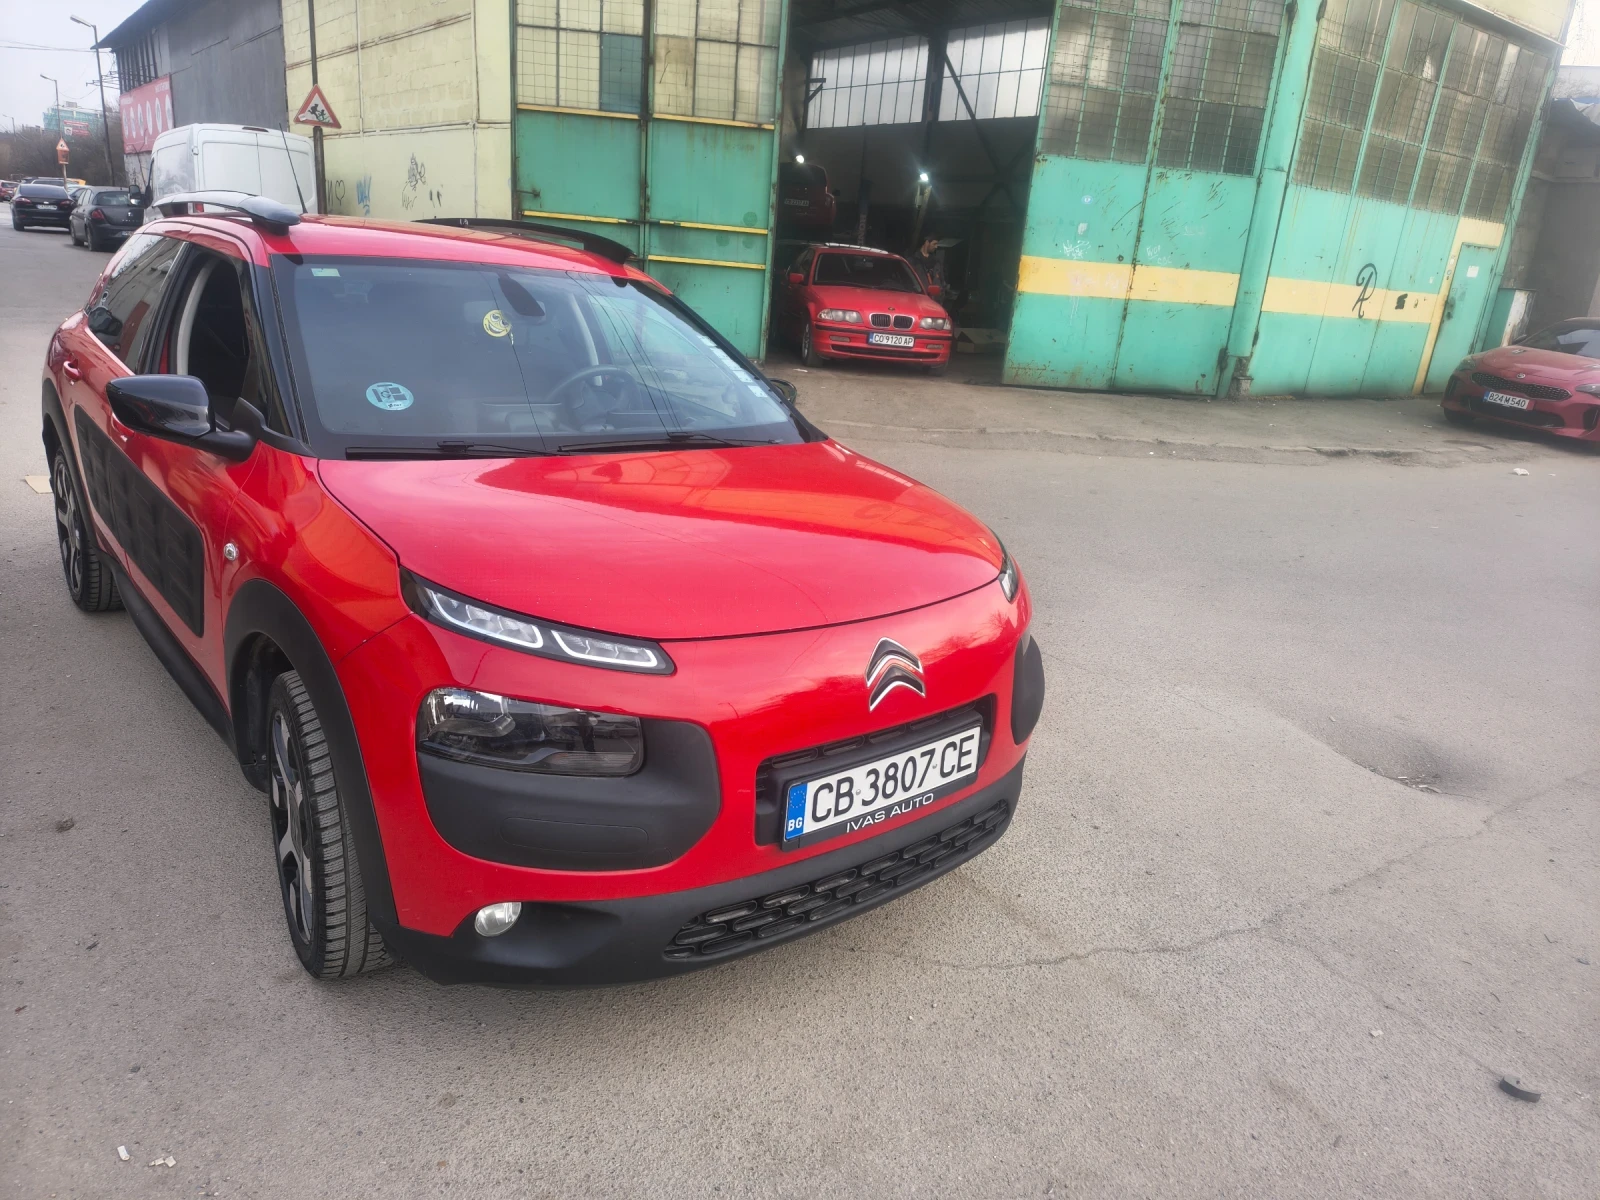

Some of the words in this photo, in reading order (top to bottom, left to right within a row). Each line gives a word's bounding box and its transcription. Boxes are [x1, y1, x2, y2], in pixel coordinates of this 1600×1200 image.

[874, 334, 884, 343] CO
[885, 336, 903, 345] 9120
[903, 337, 913, 346] AP
[811, 776, 855, 823] CB
[861, 748, 936, 807] 3807
[939, 734, 975, 779] CE
[788, 816, 803, 832] BG
[846, 810, 886, 833] IVAS
[889, 793, 934, 818] AUTO
